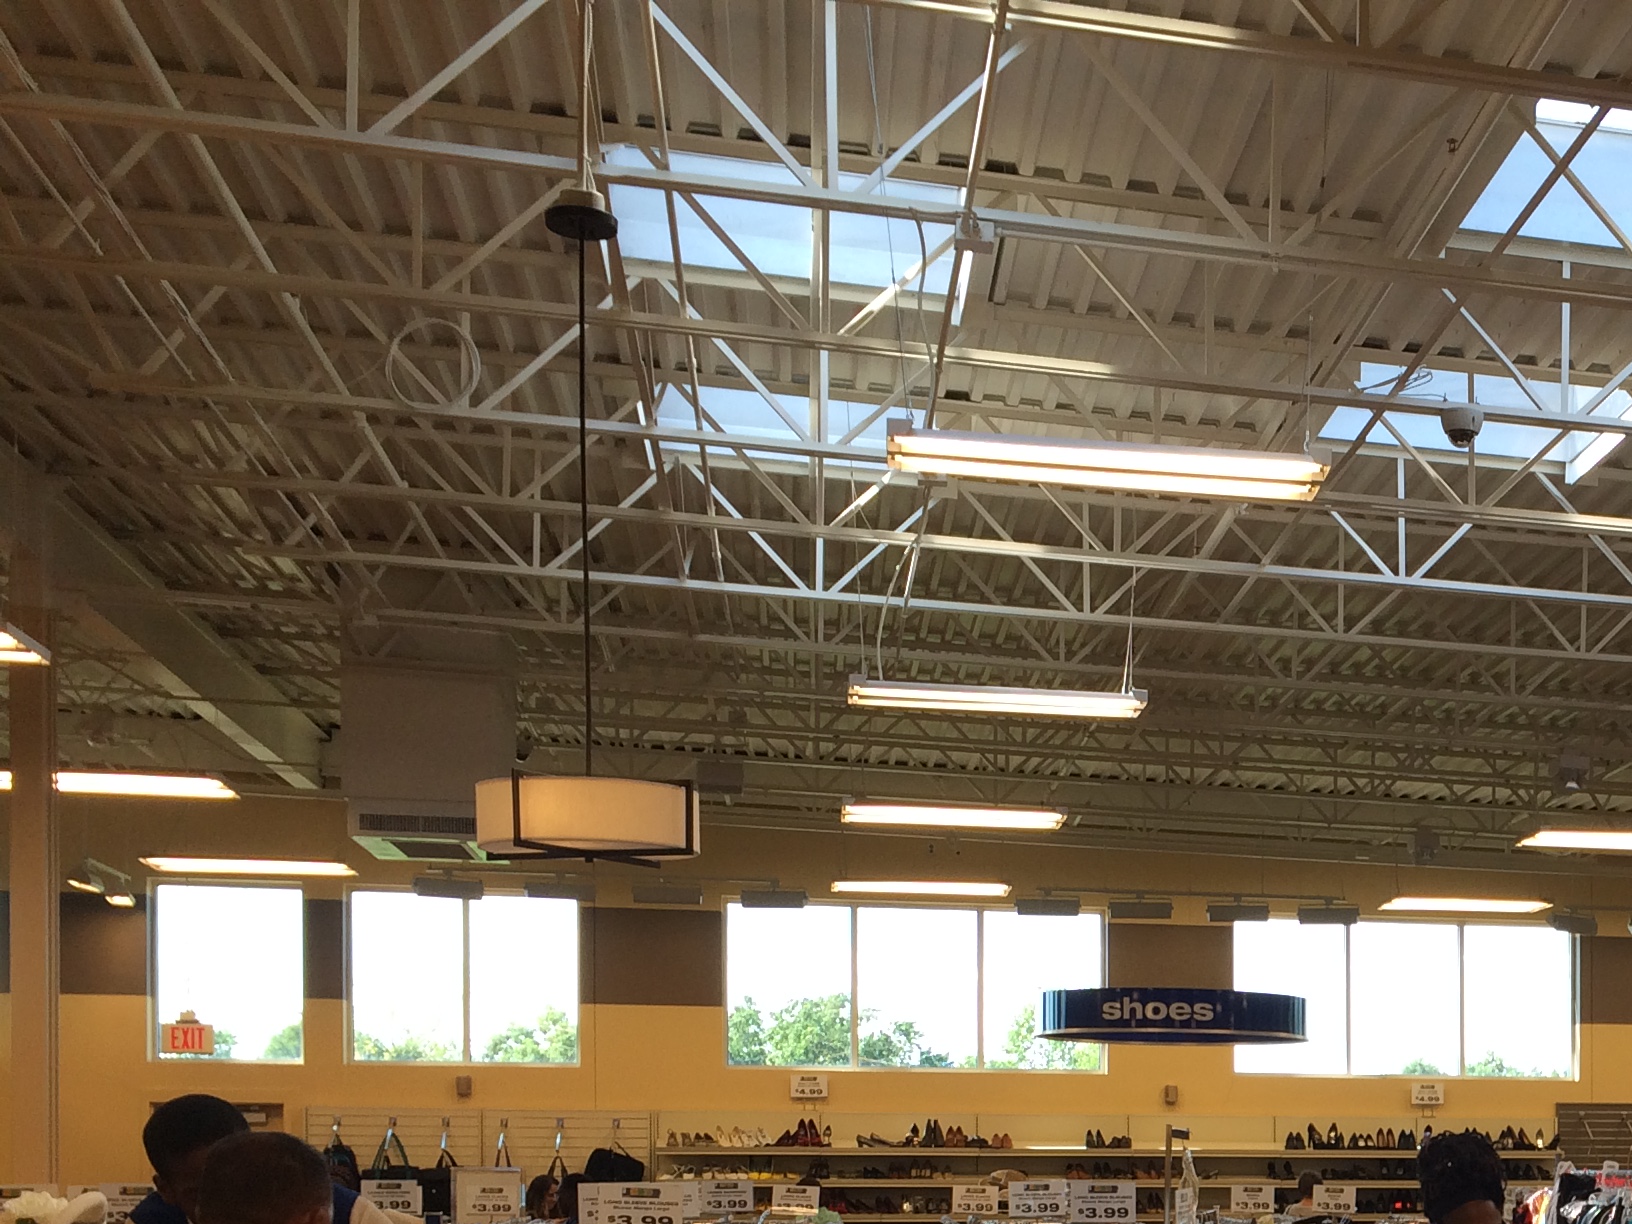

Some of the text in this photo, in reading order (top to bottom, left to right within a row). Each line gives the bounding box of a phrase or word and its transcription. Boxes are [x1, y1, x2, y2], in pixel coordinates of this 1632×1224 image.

[1102, 996, 1215, 1022] shoes
[170, 1026, 205, 1050] EXIT
[374, 1200, 412, 1210] 3.99
[472, 1203, 512, 1213] $3.99
[706, 1199, 748, 1210] $3.99
[957, 1202, 994, 1212] $3.99
[1015, 1202, 1060, 1213] $3.99
[1235, 1201, 1270, 1210] $3.99
[1316, 1202, 1351, 1211] $3.99
[1078, 1207, 1130, 1219] $3.99
